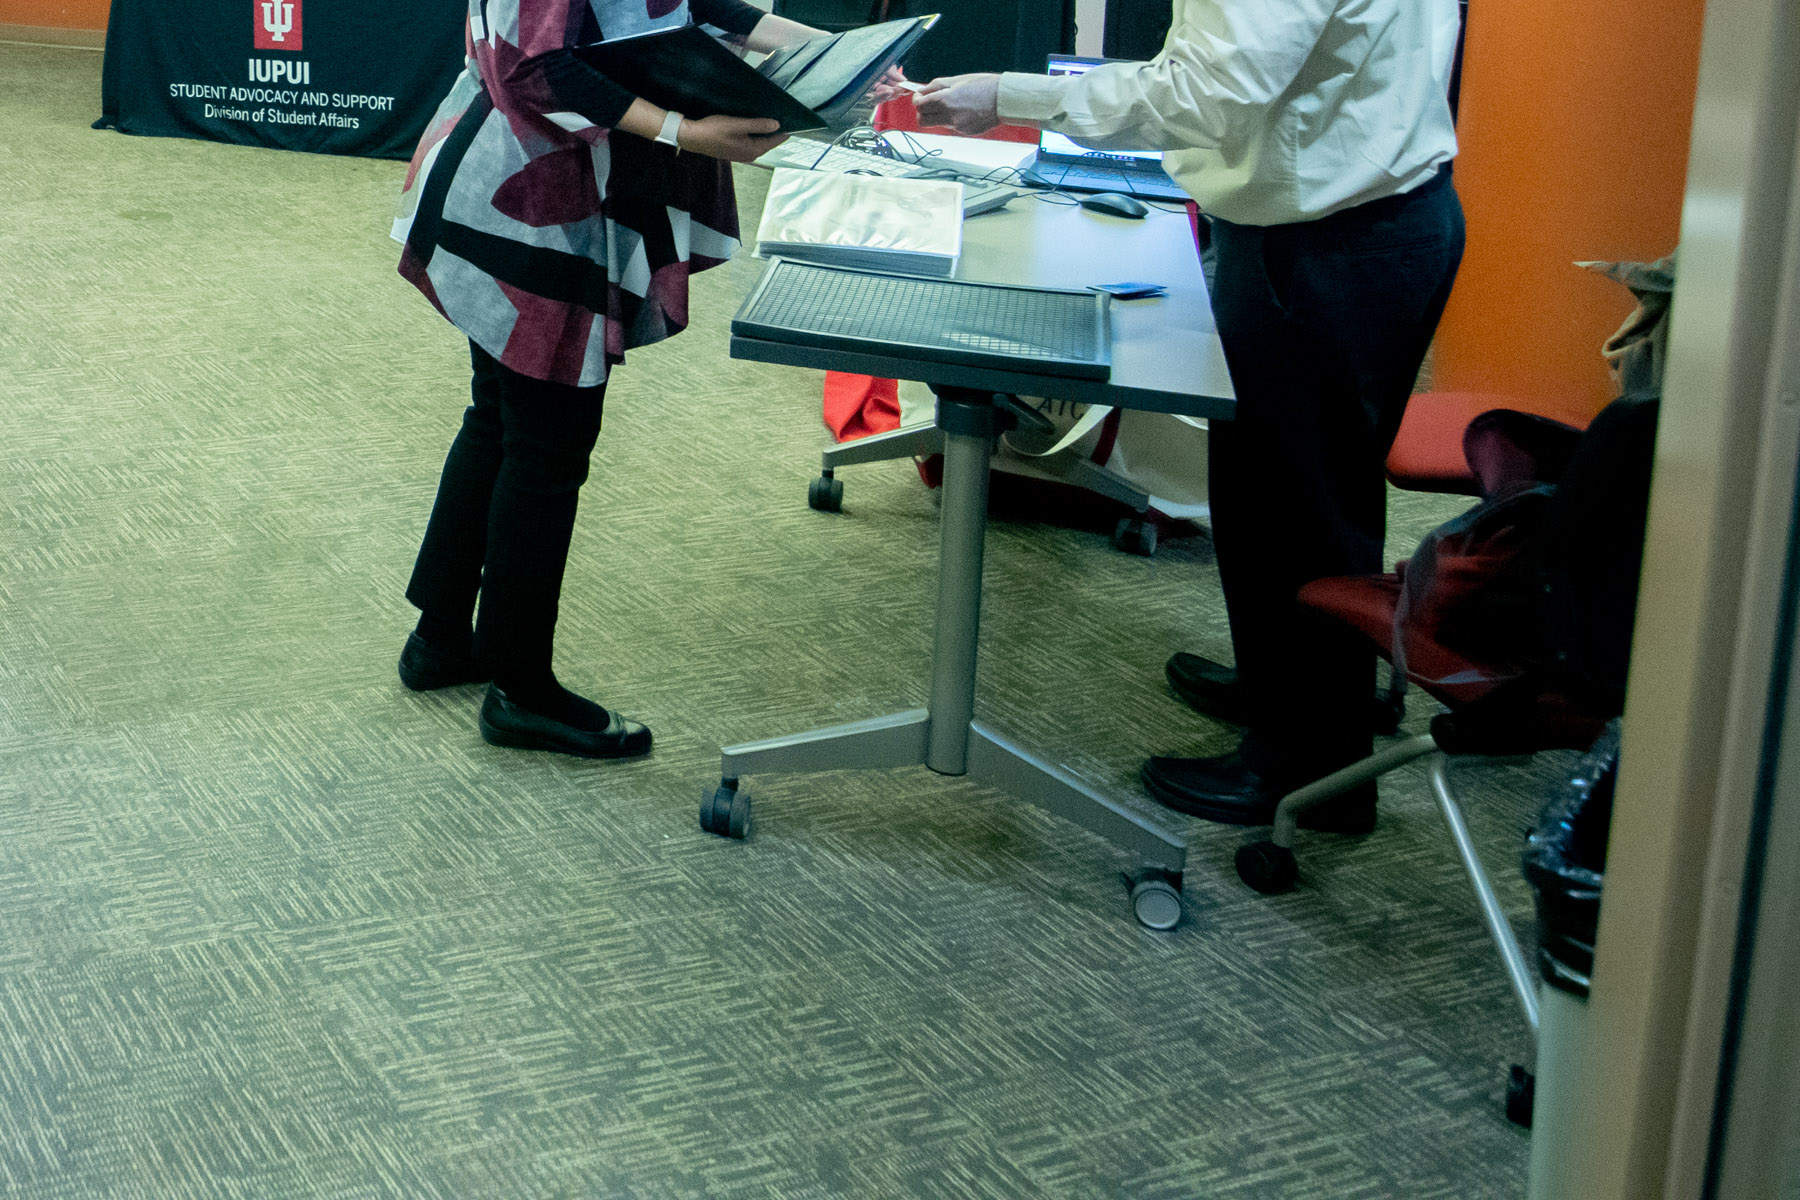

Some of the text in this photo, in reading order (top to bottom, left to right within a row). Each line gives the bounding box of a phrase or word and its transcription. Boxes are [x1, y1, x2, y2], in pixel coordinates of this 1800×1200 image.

[248, 58, 310, 85] IUPUI
[170, 83, 395, 111] STUDENT ADVOCACY AND SUPPORT
[205, 103, 359, 129] Division of Student Affairs
